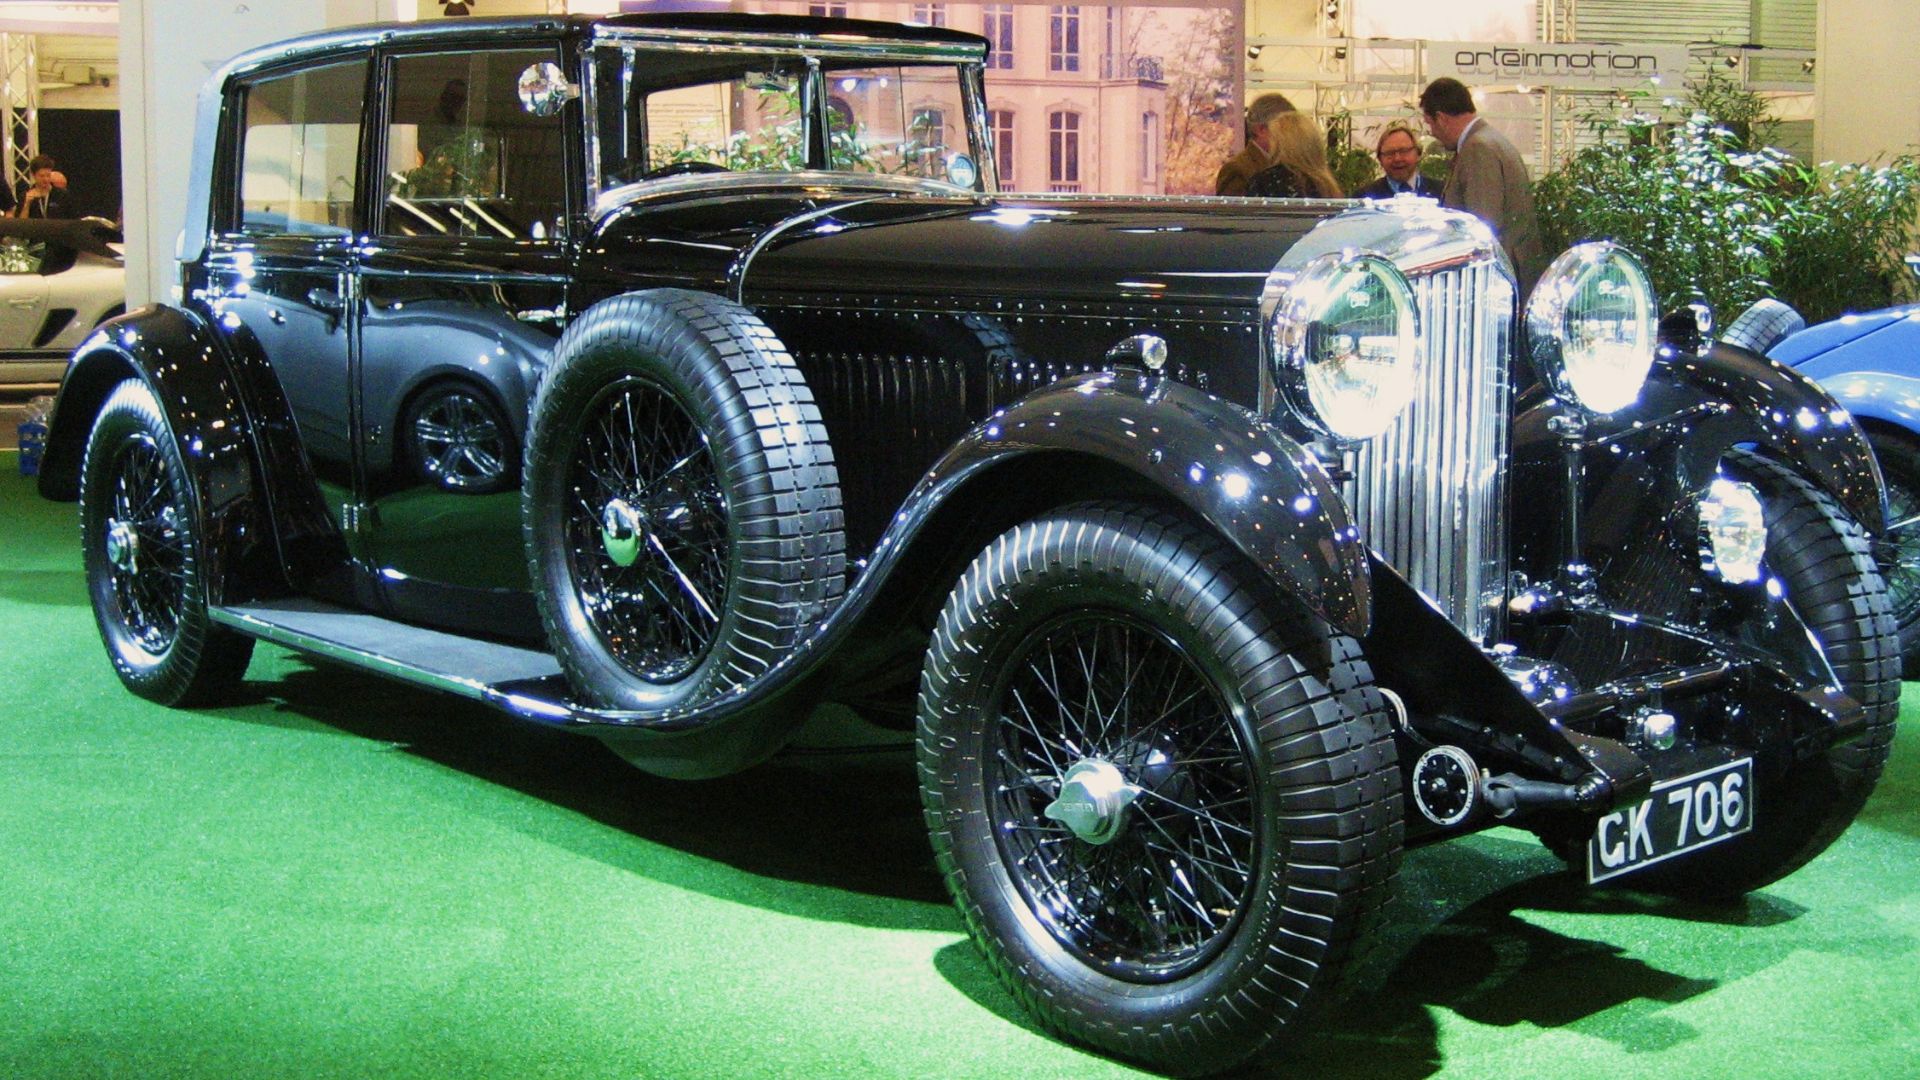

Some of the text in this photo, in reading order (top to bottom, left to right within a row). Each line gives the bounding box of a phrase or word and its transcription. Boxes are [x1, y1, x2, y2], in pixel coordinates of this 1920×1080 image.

[1455, 46, 1657, 69] arteinmotion
[1598, 772, 1745, 867] GK 706
